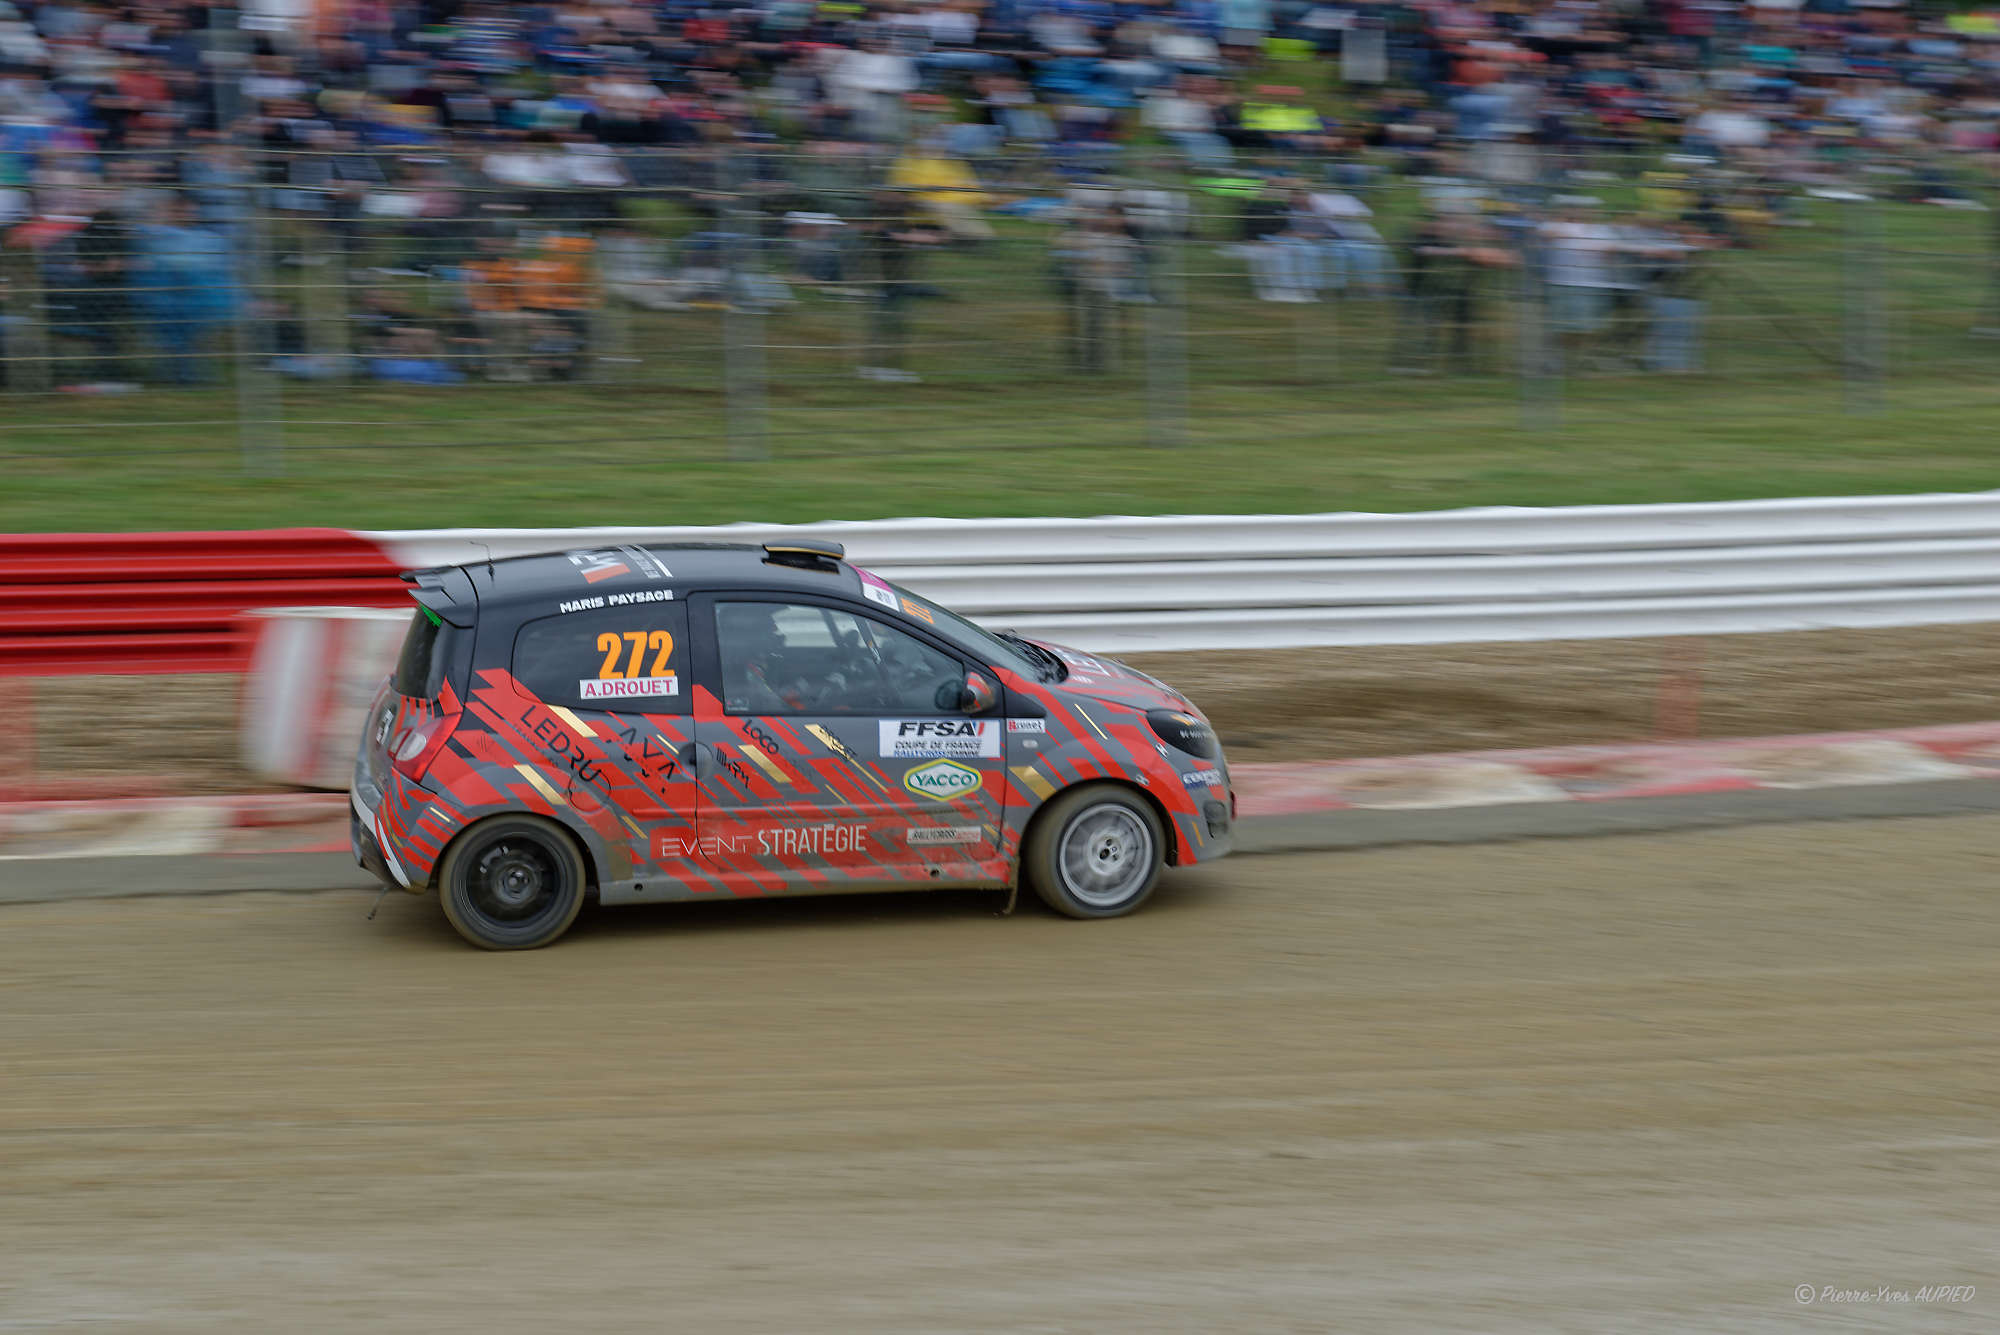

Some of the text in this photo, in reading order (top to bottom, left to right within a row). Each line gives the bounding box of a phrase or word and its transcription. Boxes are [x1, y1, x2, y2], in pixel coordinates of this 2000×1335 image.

[559, 589, 674, 614] MARIS PAYSAGE
[597, 630, 676, 679] 272
[585, 680, 673, 696] A.DROUET
[742, 719, 779, 755] LOCO
[898, 722, 976, 737] FFSA
[520, 705, 601, 782] LEDRU
[915, 774, 973, 787] YACCO
[661, 835, 753, 857] EVENT
